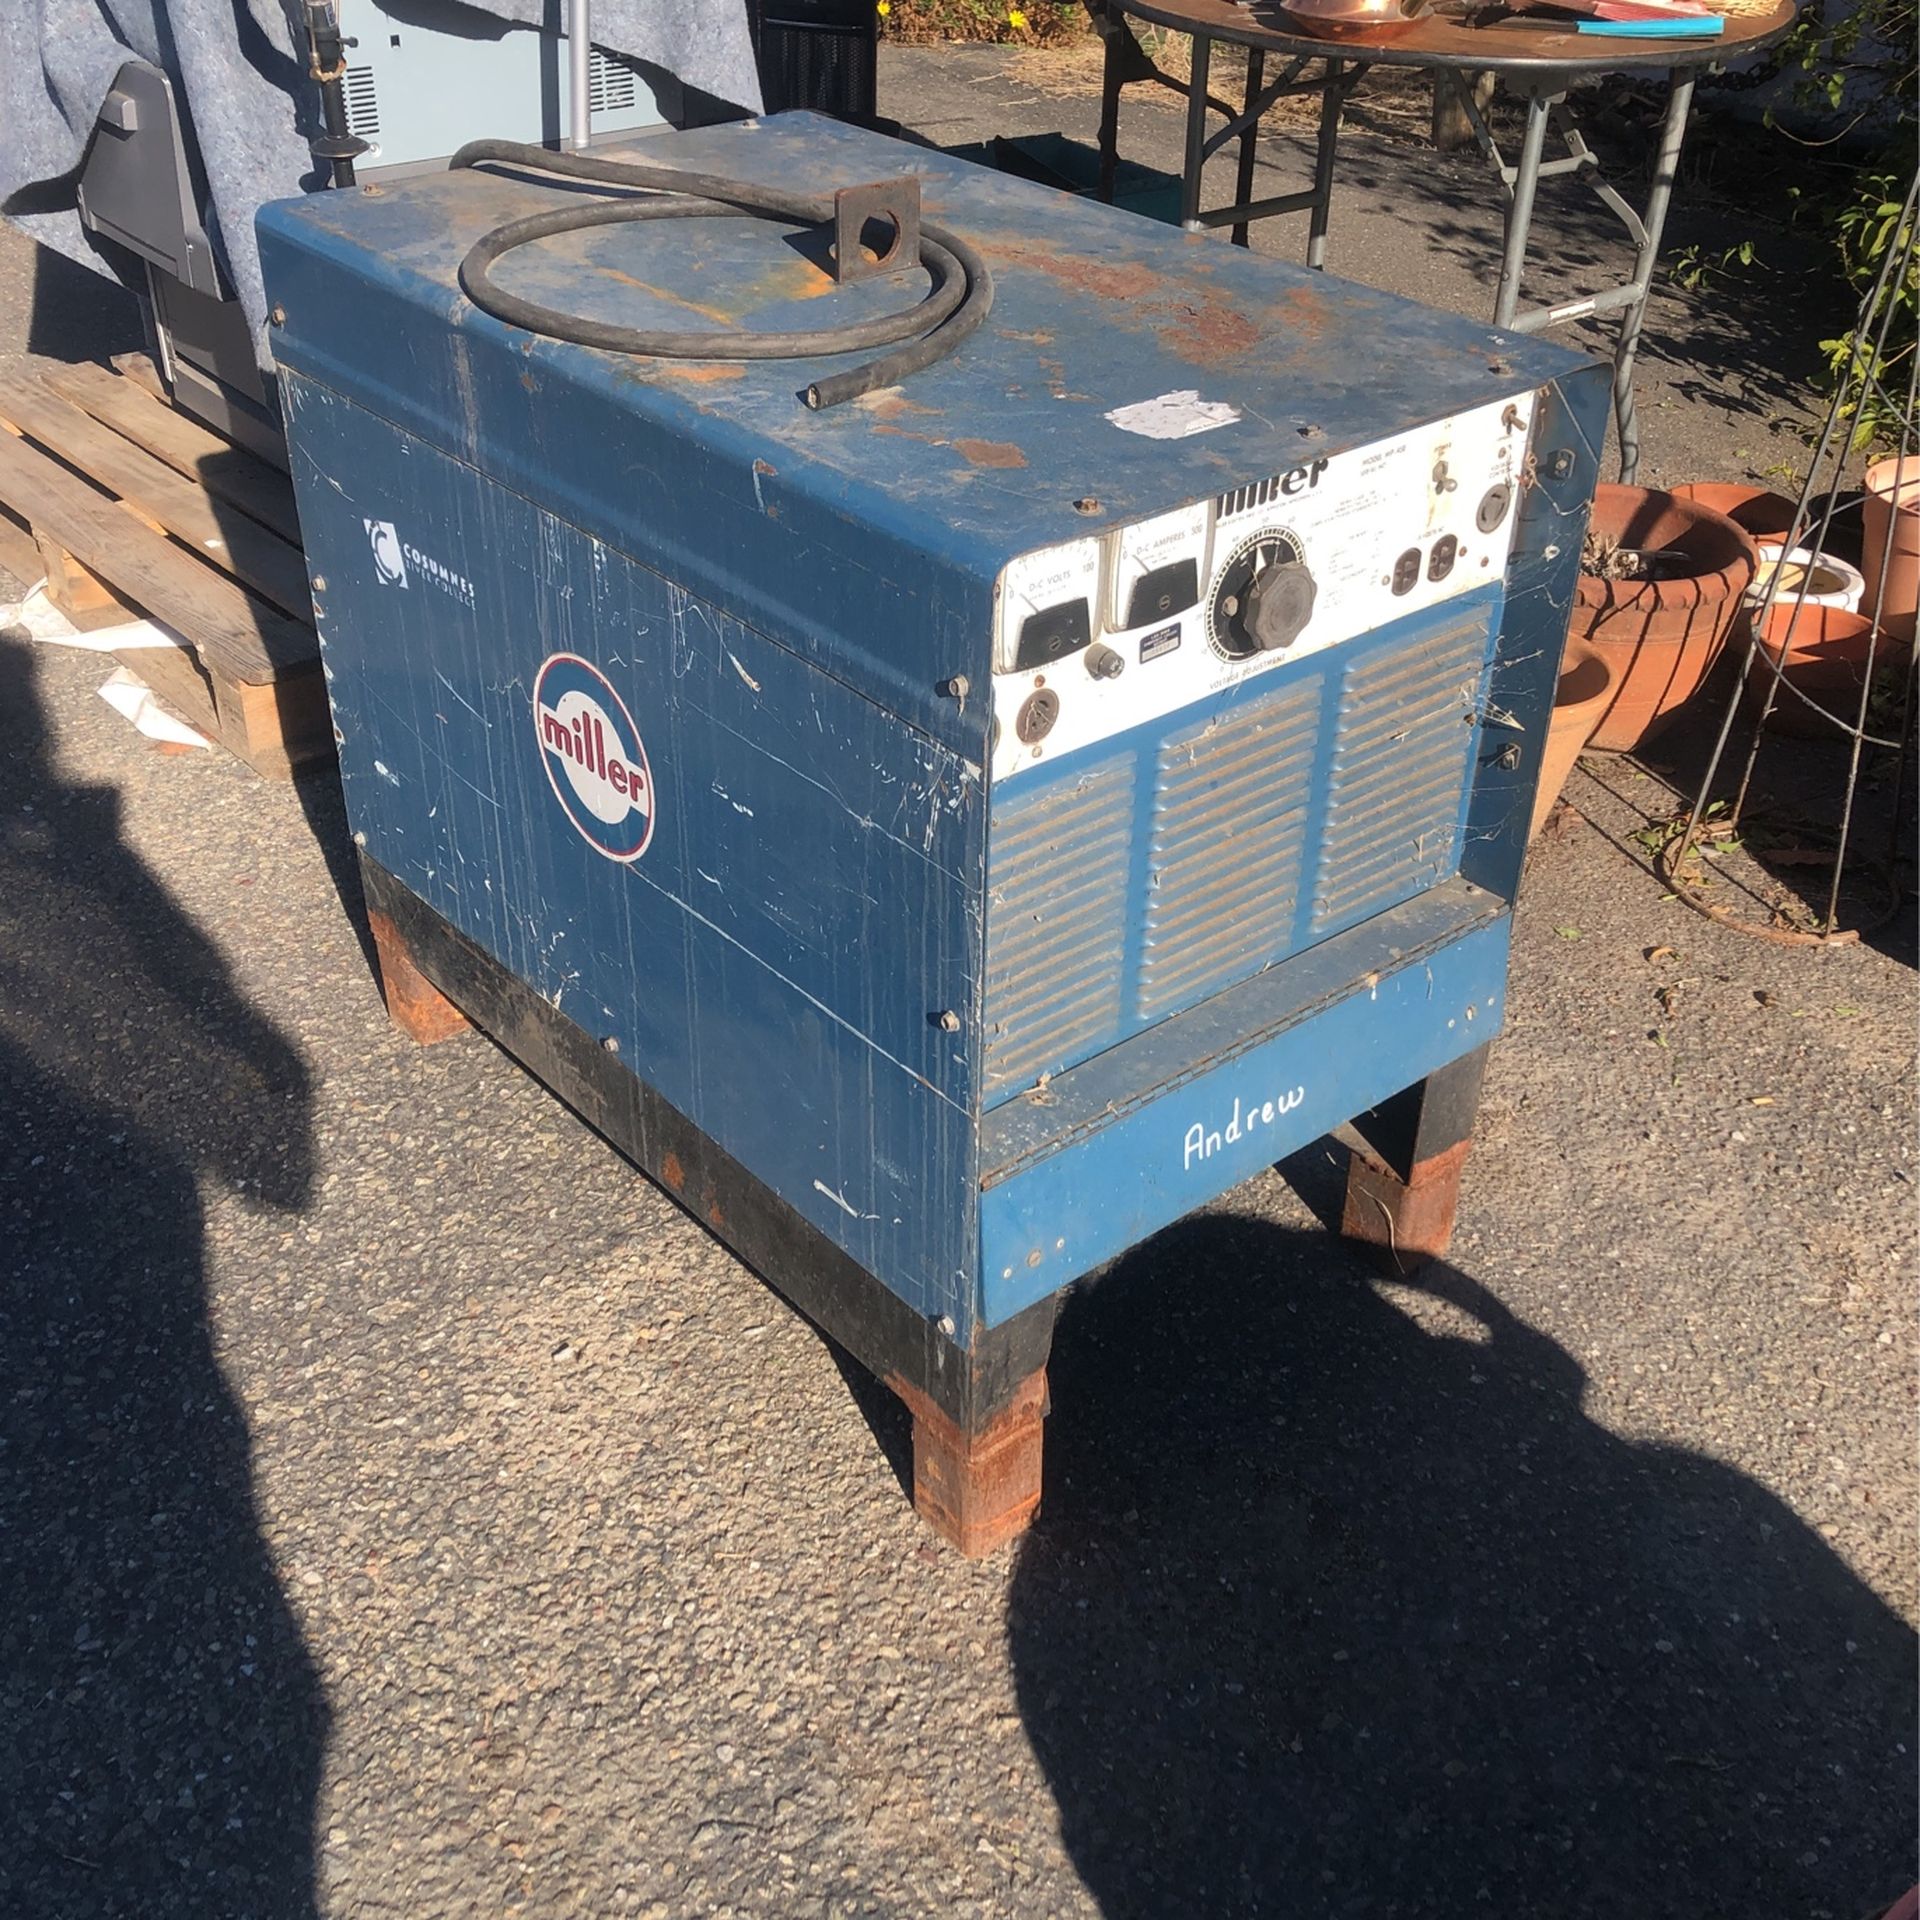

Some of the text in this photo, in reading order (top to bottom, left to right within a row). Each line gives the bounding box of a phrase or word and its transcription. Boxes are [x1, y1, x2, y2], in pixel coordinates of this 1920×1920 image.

[1153, 531, 1186, 548] AMPERES
[1047, 570, 1071, 585] VOLTS
[1083, 561, 1095, 573] 100
[543, 710, 644, 802] miller
[1184, 1085, 1304, 1171] Andrew
